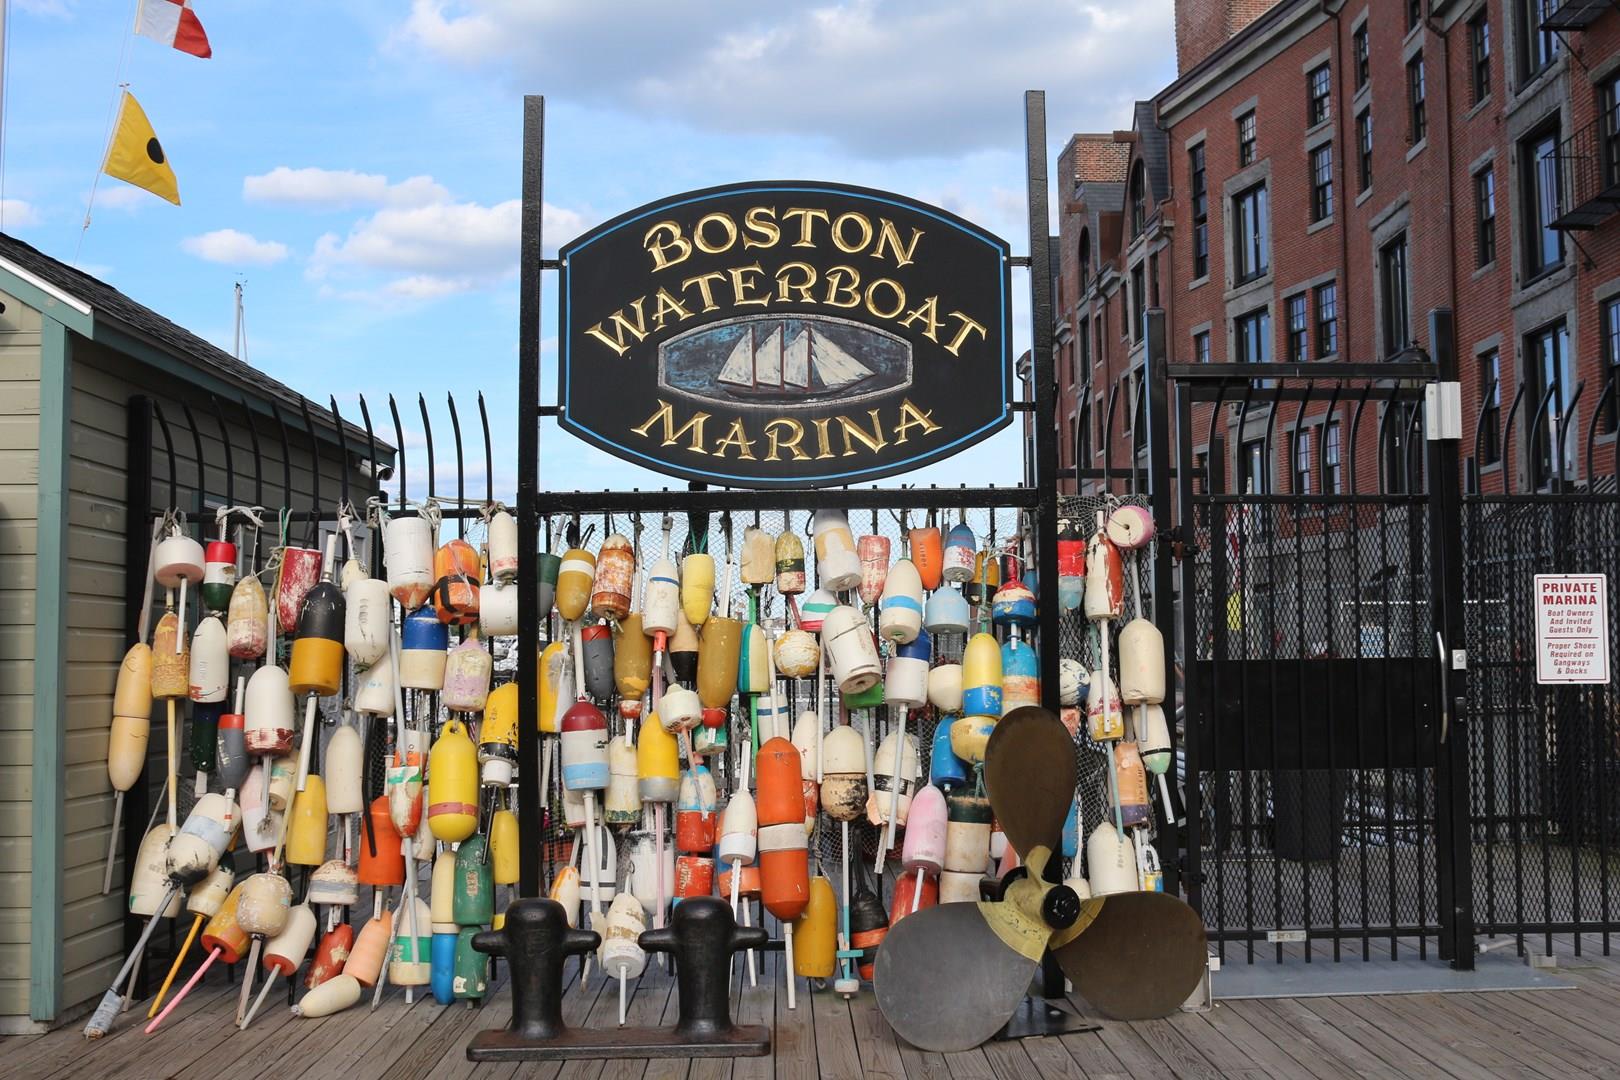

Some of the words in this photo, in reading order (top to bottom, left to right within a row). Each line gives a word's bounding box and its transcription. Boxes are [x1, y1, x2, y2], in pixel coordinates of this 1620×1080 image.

[643, 206, 926, 273] BOSTON
[584, 261, 988, 358] WATERBOAT
[630, 398, 943, 463] MARINA
[1542, 583, 1598, 593] PRIVATE
[1543, 595, 1598, 605] MARINA
[1547, 609, 1564, 617] Boat
[1566, 609, 1594, 617] Owners
[1549, 626, 1574, 634] Guests
[1576, 626, 1593, 634] Only
[1547, 642, 1571, 650] Proper
[1553, 659, 1591, 667] Gangways
[1565, 667, 1588, 675] Docks
